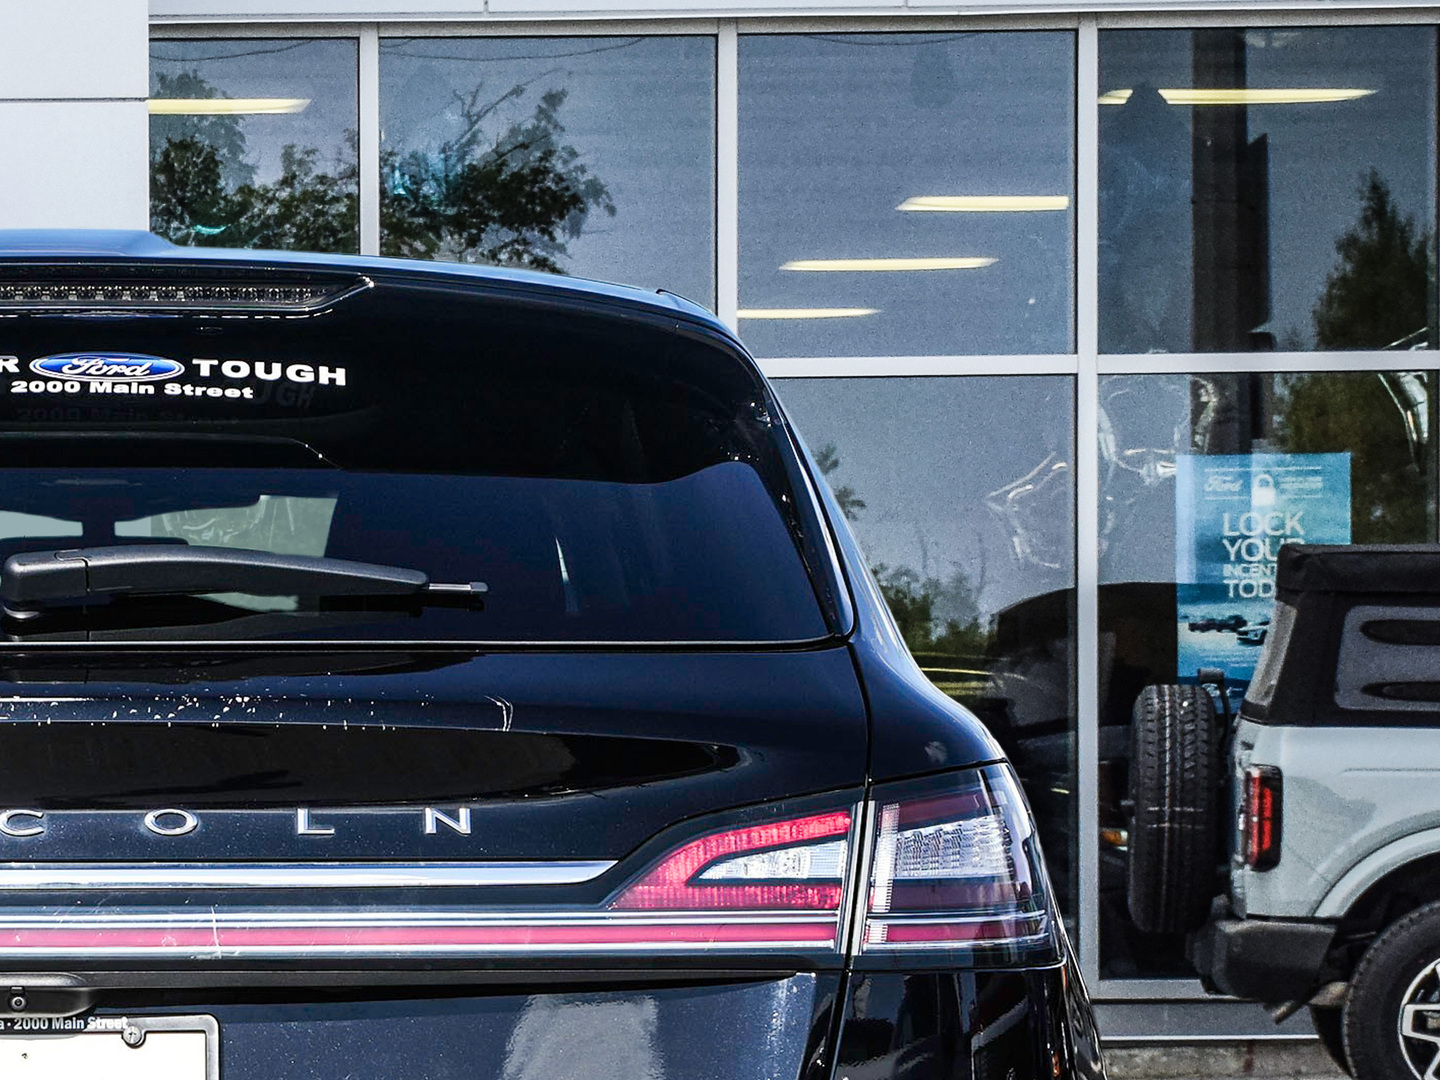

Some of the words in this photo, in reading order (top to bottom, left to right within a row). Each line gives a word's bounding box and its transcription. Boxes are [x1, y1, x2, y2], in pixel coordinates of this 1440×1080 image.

[192, 358, 346, 386] TOUGH
[10, 379, 81, 394] 2000
[89, 381, 155, 395] Main
[163, 383, 254, 399] Street
[1222, 511, 1304, 537] LOCK
[1222, 537, 1306, 562] YOU
[1222, 579, 1277, 598] TOD
[13, 1017, 49, 1031] 2000
[51, 1017, 85, 1030] Main
[87, 1017, 128, 1030] Street
